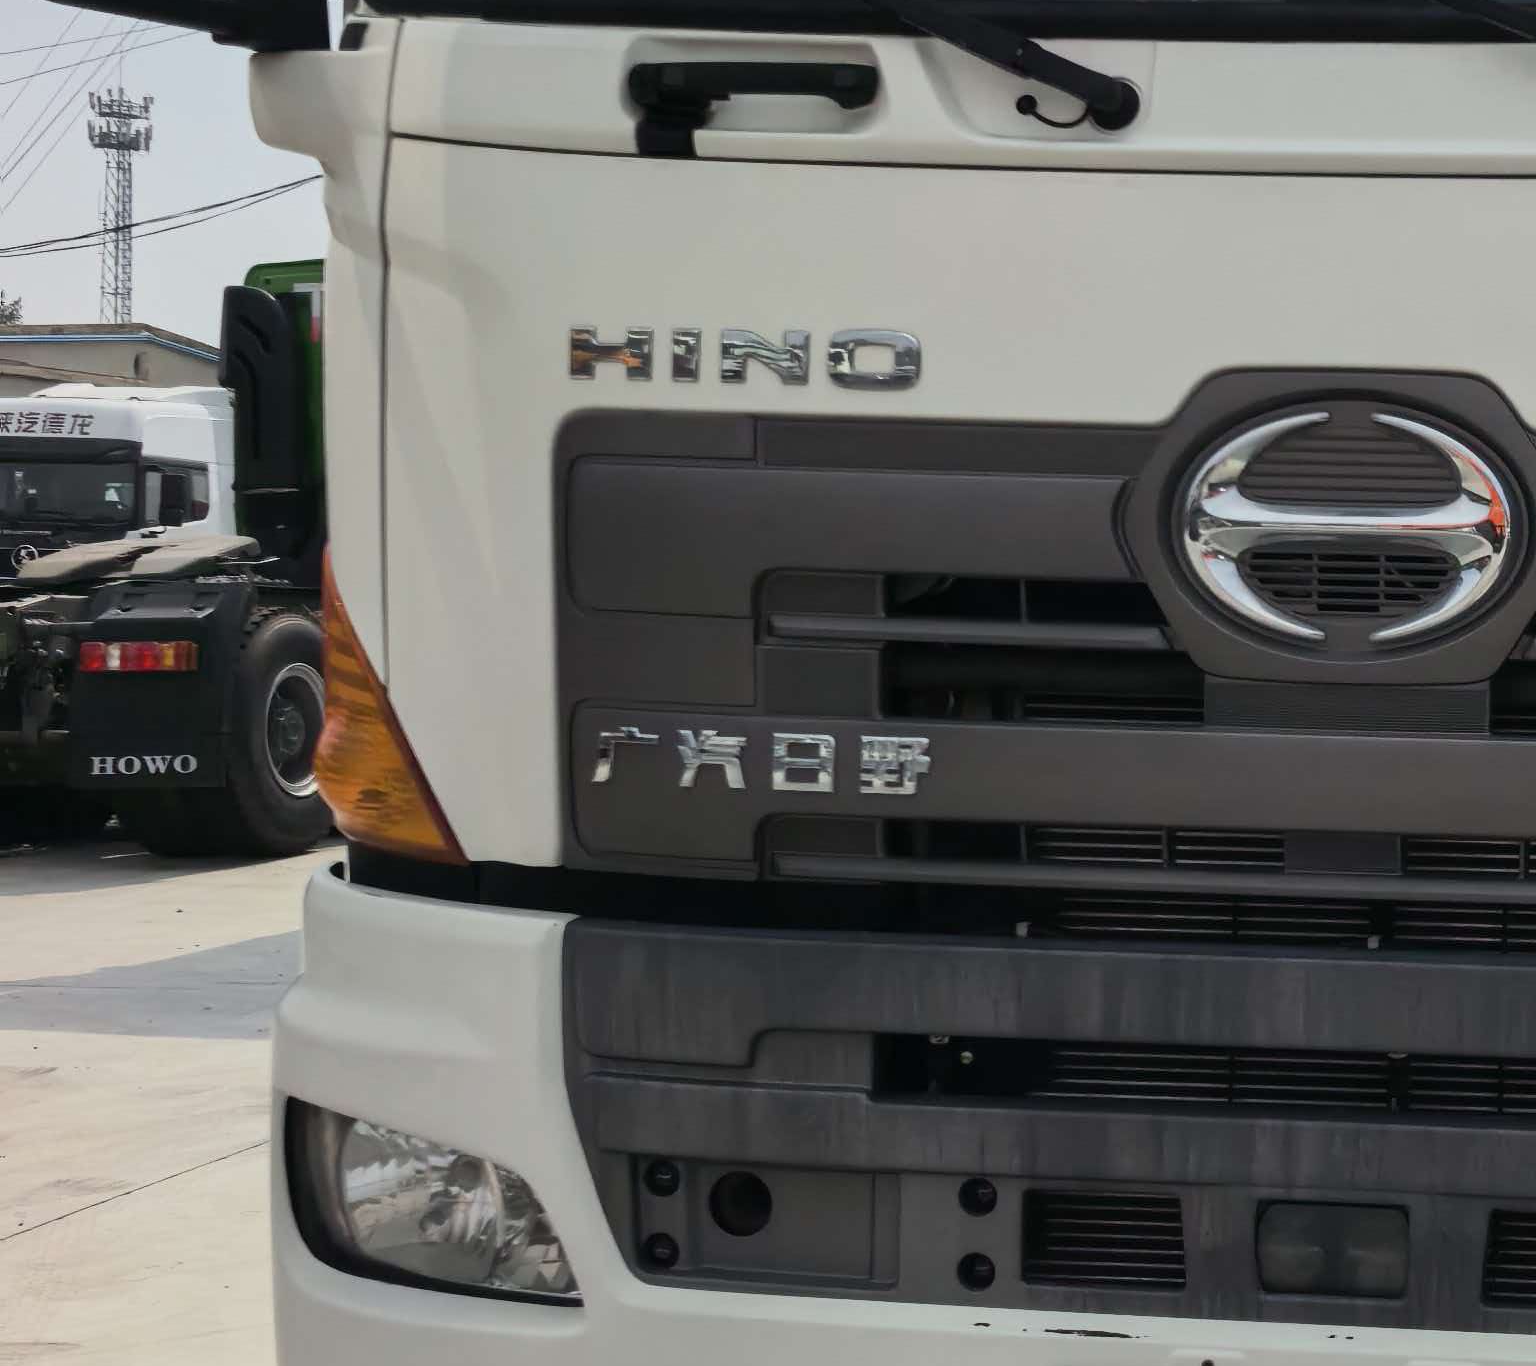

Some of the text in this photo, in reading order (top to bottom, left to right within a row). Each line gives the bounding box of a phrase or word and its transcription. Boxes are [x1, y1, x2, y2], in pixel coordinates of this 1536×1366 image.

[569, 325, 922, 390] HINO
[89, 754, 198, 775] HOWO
[592, 727, 931, 795] 广汽日野
